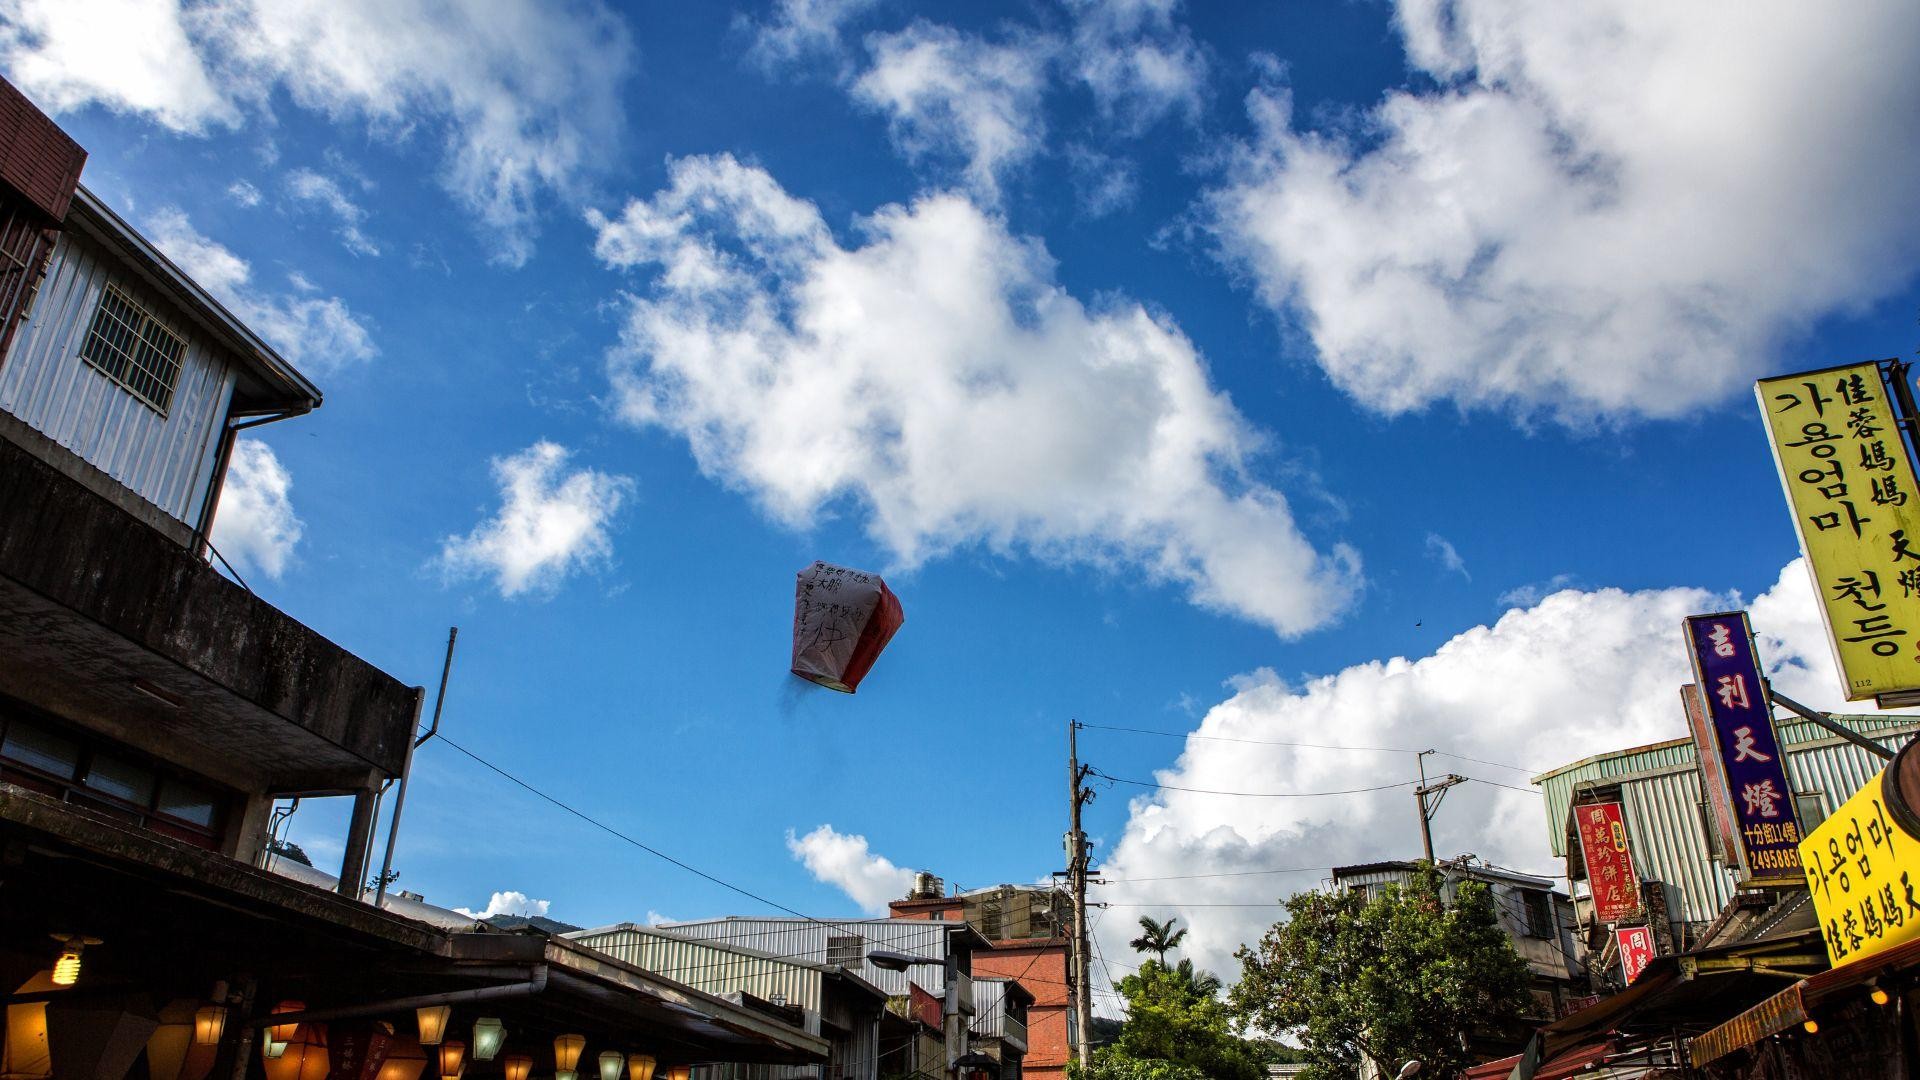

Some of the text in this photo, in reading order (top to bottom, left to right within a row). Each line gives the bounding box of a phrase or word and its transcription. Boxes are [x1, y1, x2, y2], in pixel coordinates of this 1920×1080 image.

[1775, 382, 1907, 657] 가용엄마 천등
[1708, 623, 1781, 818] 吉利天燈
[1855, 679, 1872, 688] 112
[1744, 821, 1799, 845] 十分街114號
[1809, 799, 1896, 907] 가용엄마
